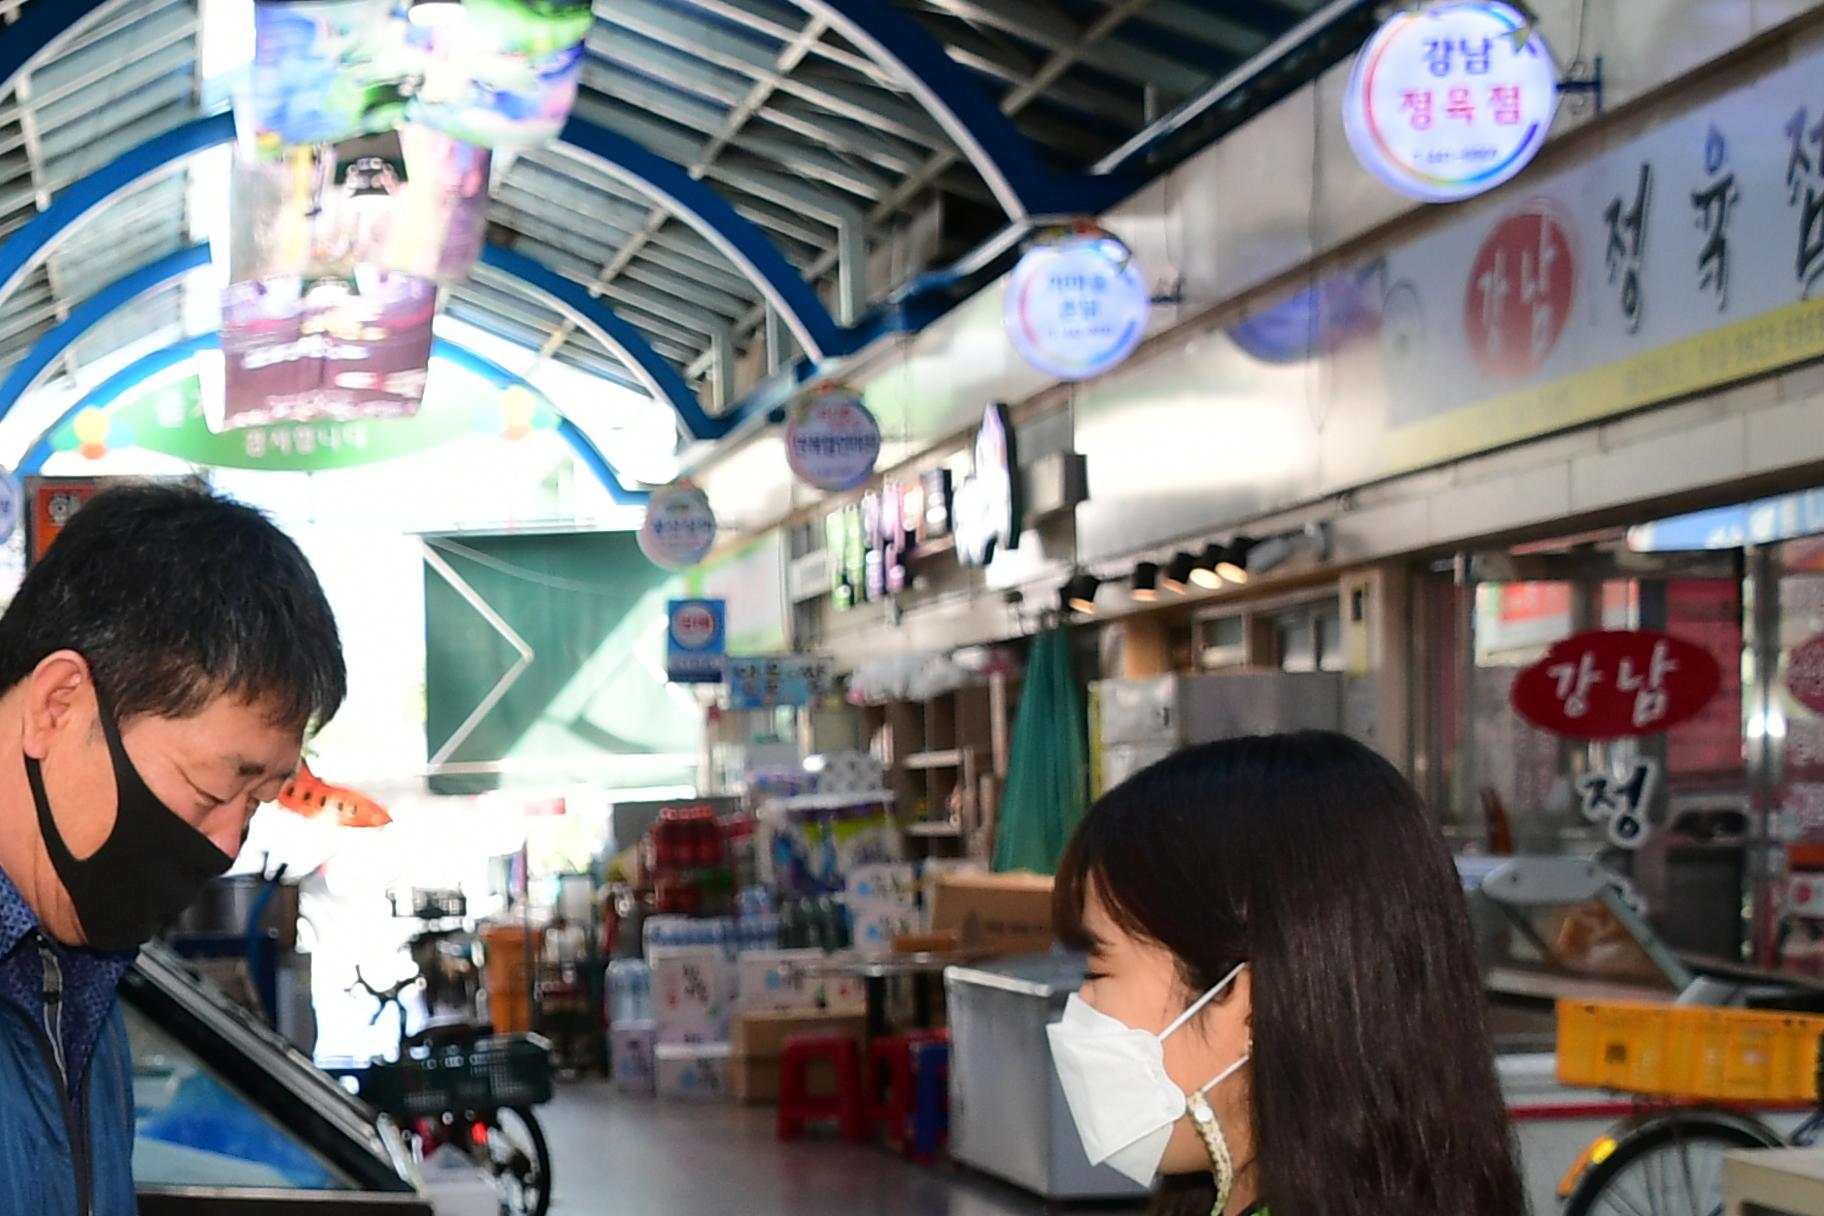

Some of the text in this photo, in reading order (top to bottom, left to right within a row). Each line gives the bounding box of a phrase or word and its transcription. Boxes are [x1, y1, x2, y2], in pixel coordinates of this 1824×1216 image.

[1423, 37, 1494, 77] 강남
[1399, 85, 1520, 129] 정육점
[1476, 210, 1557, 360] 강남
[1548, 640, 1678, 728] 강남
[1582, 765, 1649, 839] 정
